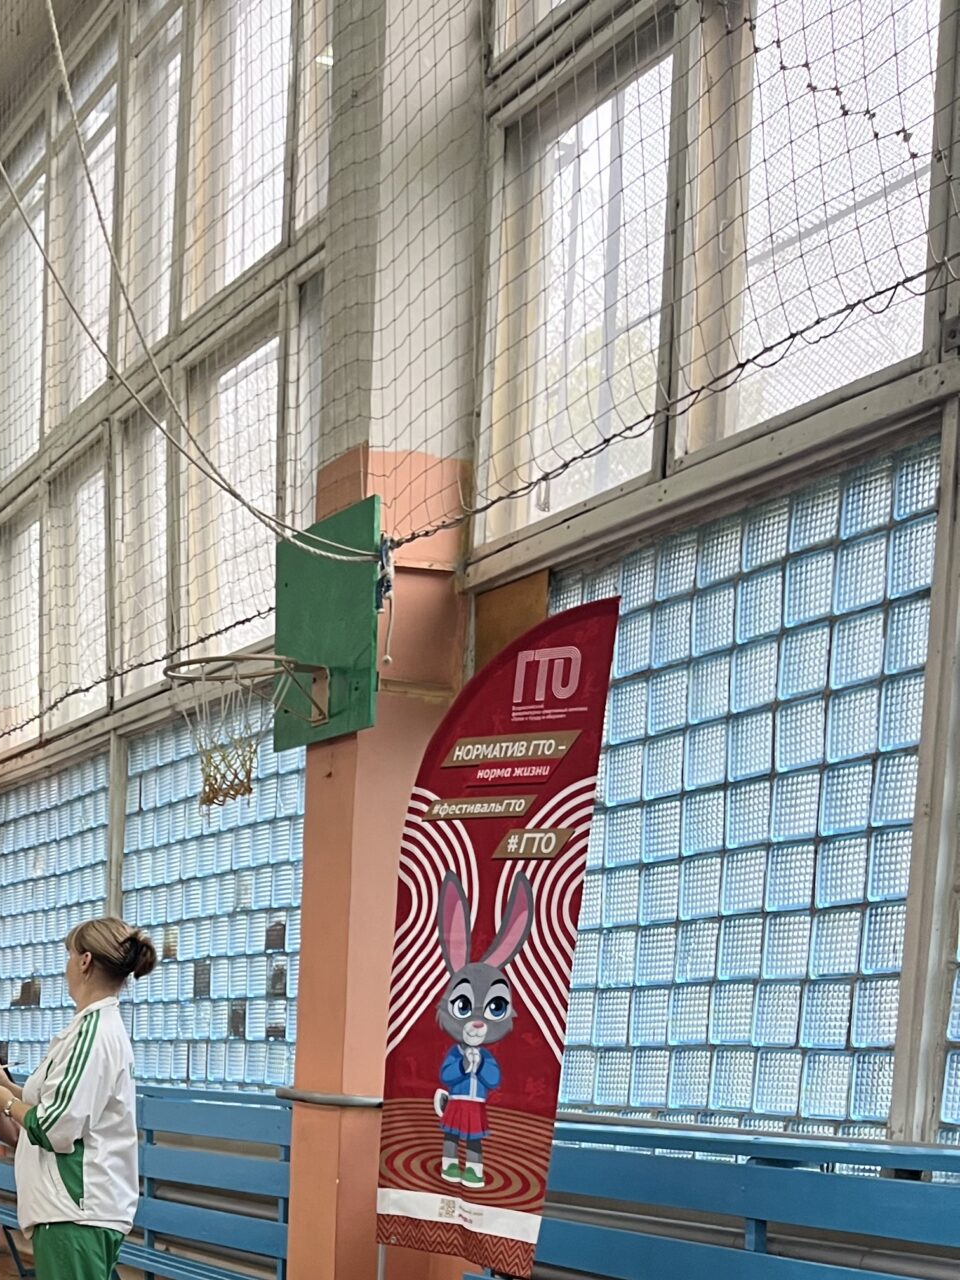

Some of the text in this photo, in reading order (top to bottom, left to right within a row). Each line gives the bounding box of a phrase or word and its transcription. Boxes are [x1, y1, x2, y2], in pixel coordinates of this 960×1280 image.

[512, 645, 582, 703] ГТО
[453, 741, 528, 761] НОРМАТИВ
[528, 739, 556, 756] ГТО
[476, 765, 550, 781] норма жизни
[432, 799, 525, 817] #фестивальГТО
[506, 832, 557, 854] #ГТО
